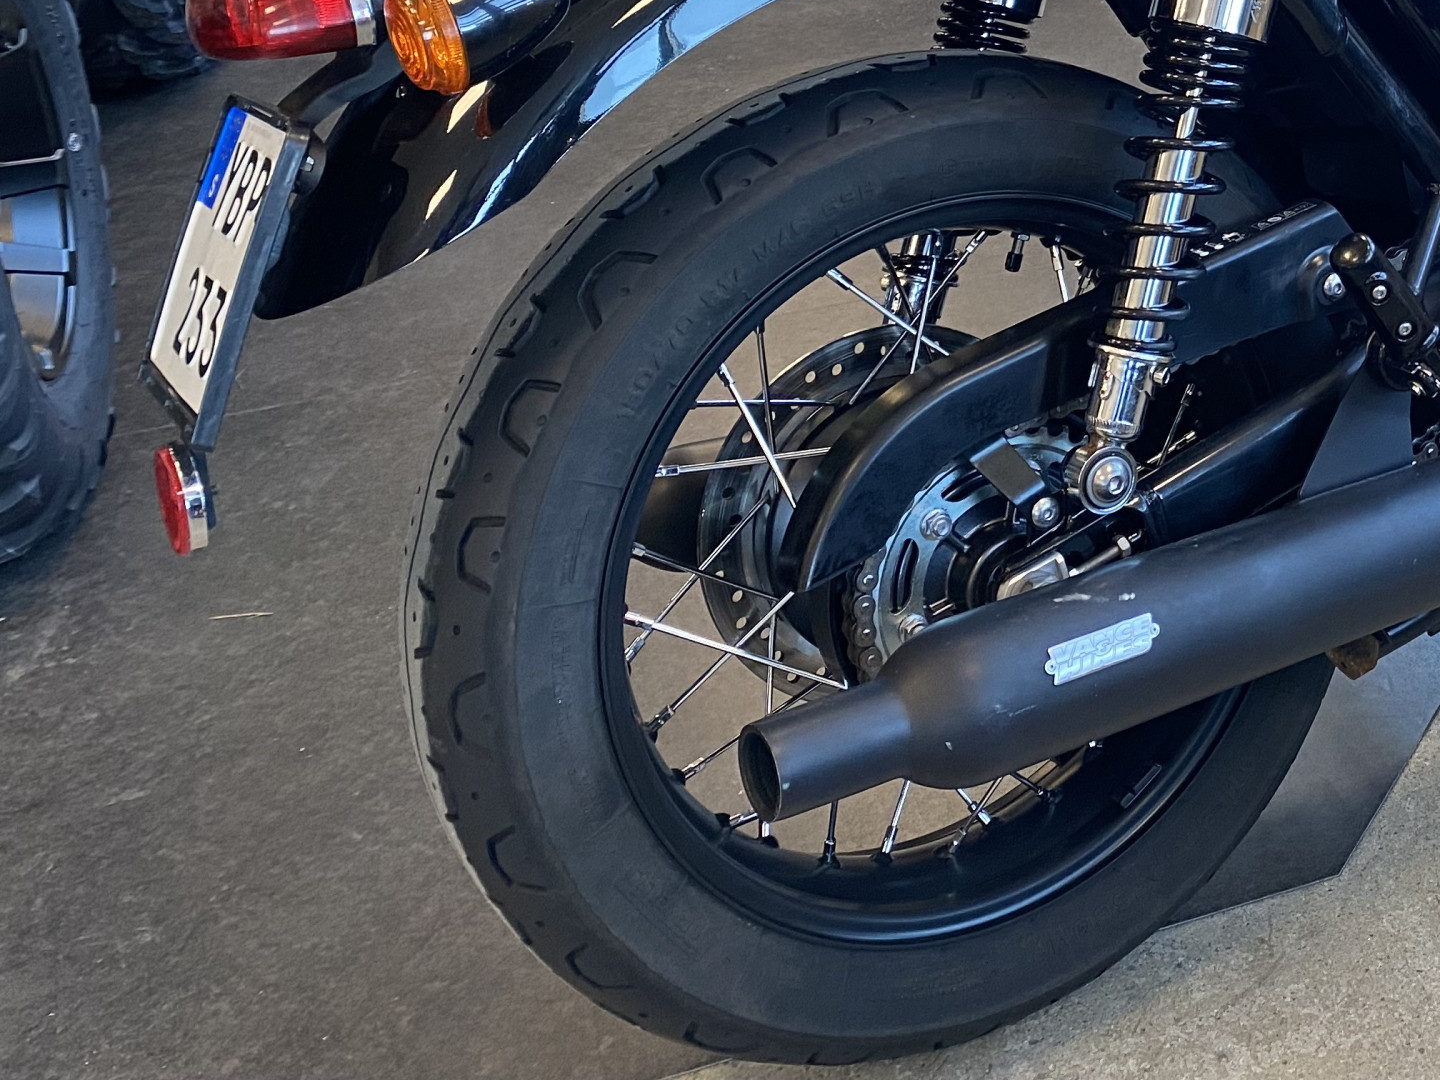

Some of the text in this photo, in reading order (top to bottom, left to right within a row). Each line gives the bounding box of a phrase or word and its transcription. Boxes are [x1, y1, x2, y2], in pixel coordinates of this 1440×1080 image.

[212, 141, 272, 242] YBP
[173, 267, 227, 378] 233
[1053, 617, 1151, 663] VANCE
[1056, 634, 1151, 681] HINES
